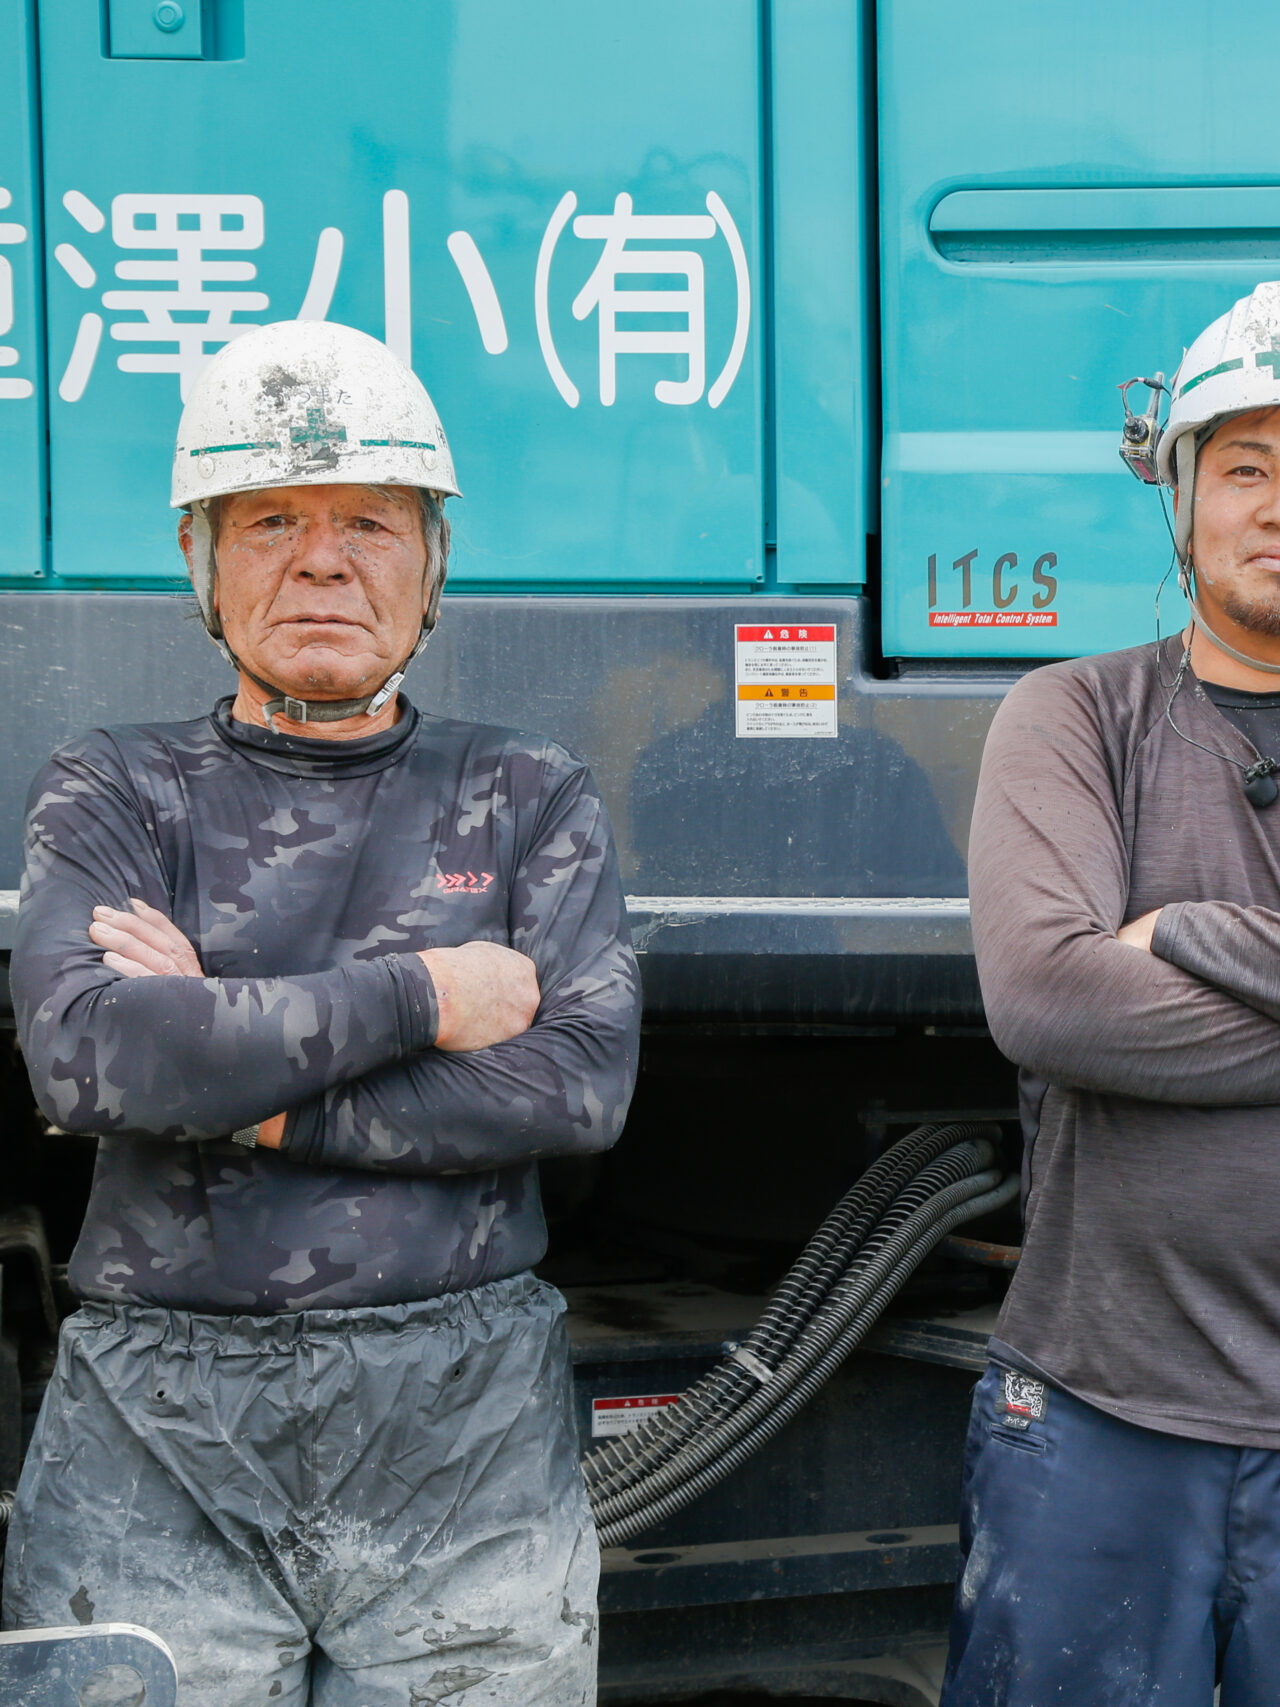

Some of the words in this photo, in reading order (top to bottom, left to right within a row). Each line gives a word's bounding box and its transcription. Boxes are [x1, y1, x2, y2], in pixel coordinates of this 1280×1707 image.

[927, 548, 1058, 609] ITCS
[933, 613, 972, 626] Intelligent
[974, 613, 994, 624] Total
[995, 613, 1024, 624] Control
[1025, 613, 1053, 626] System
